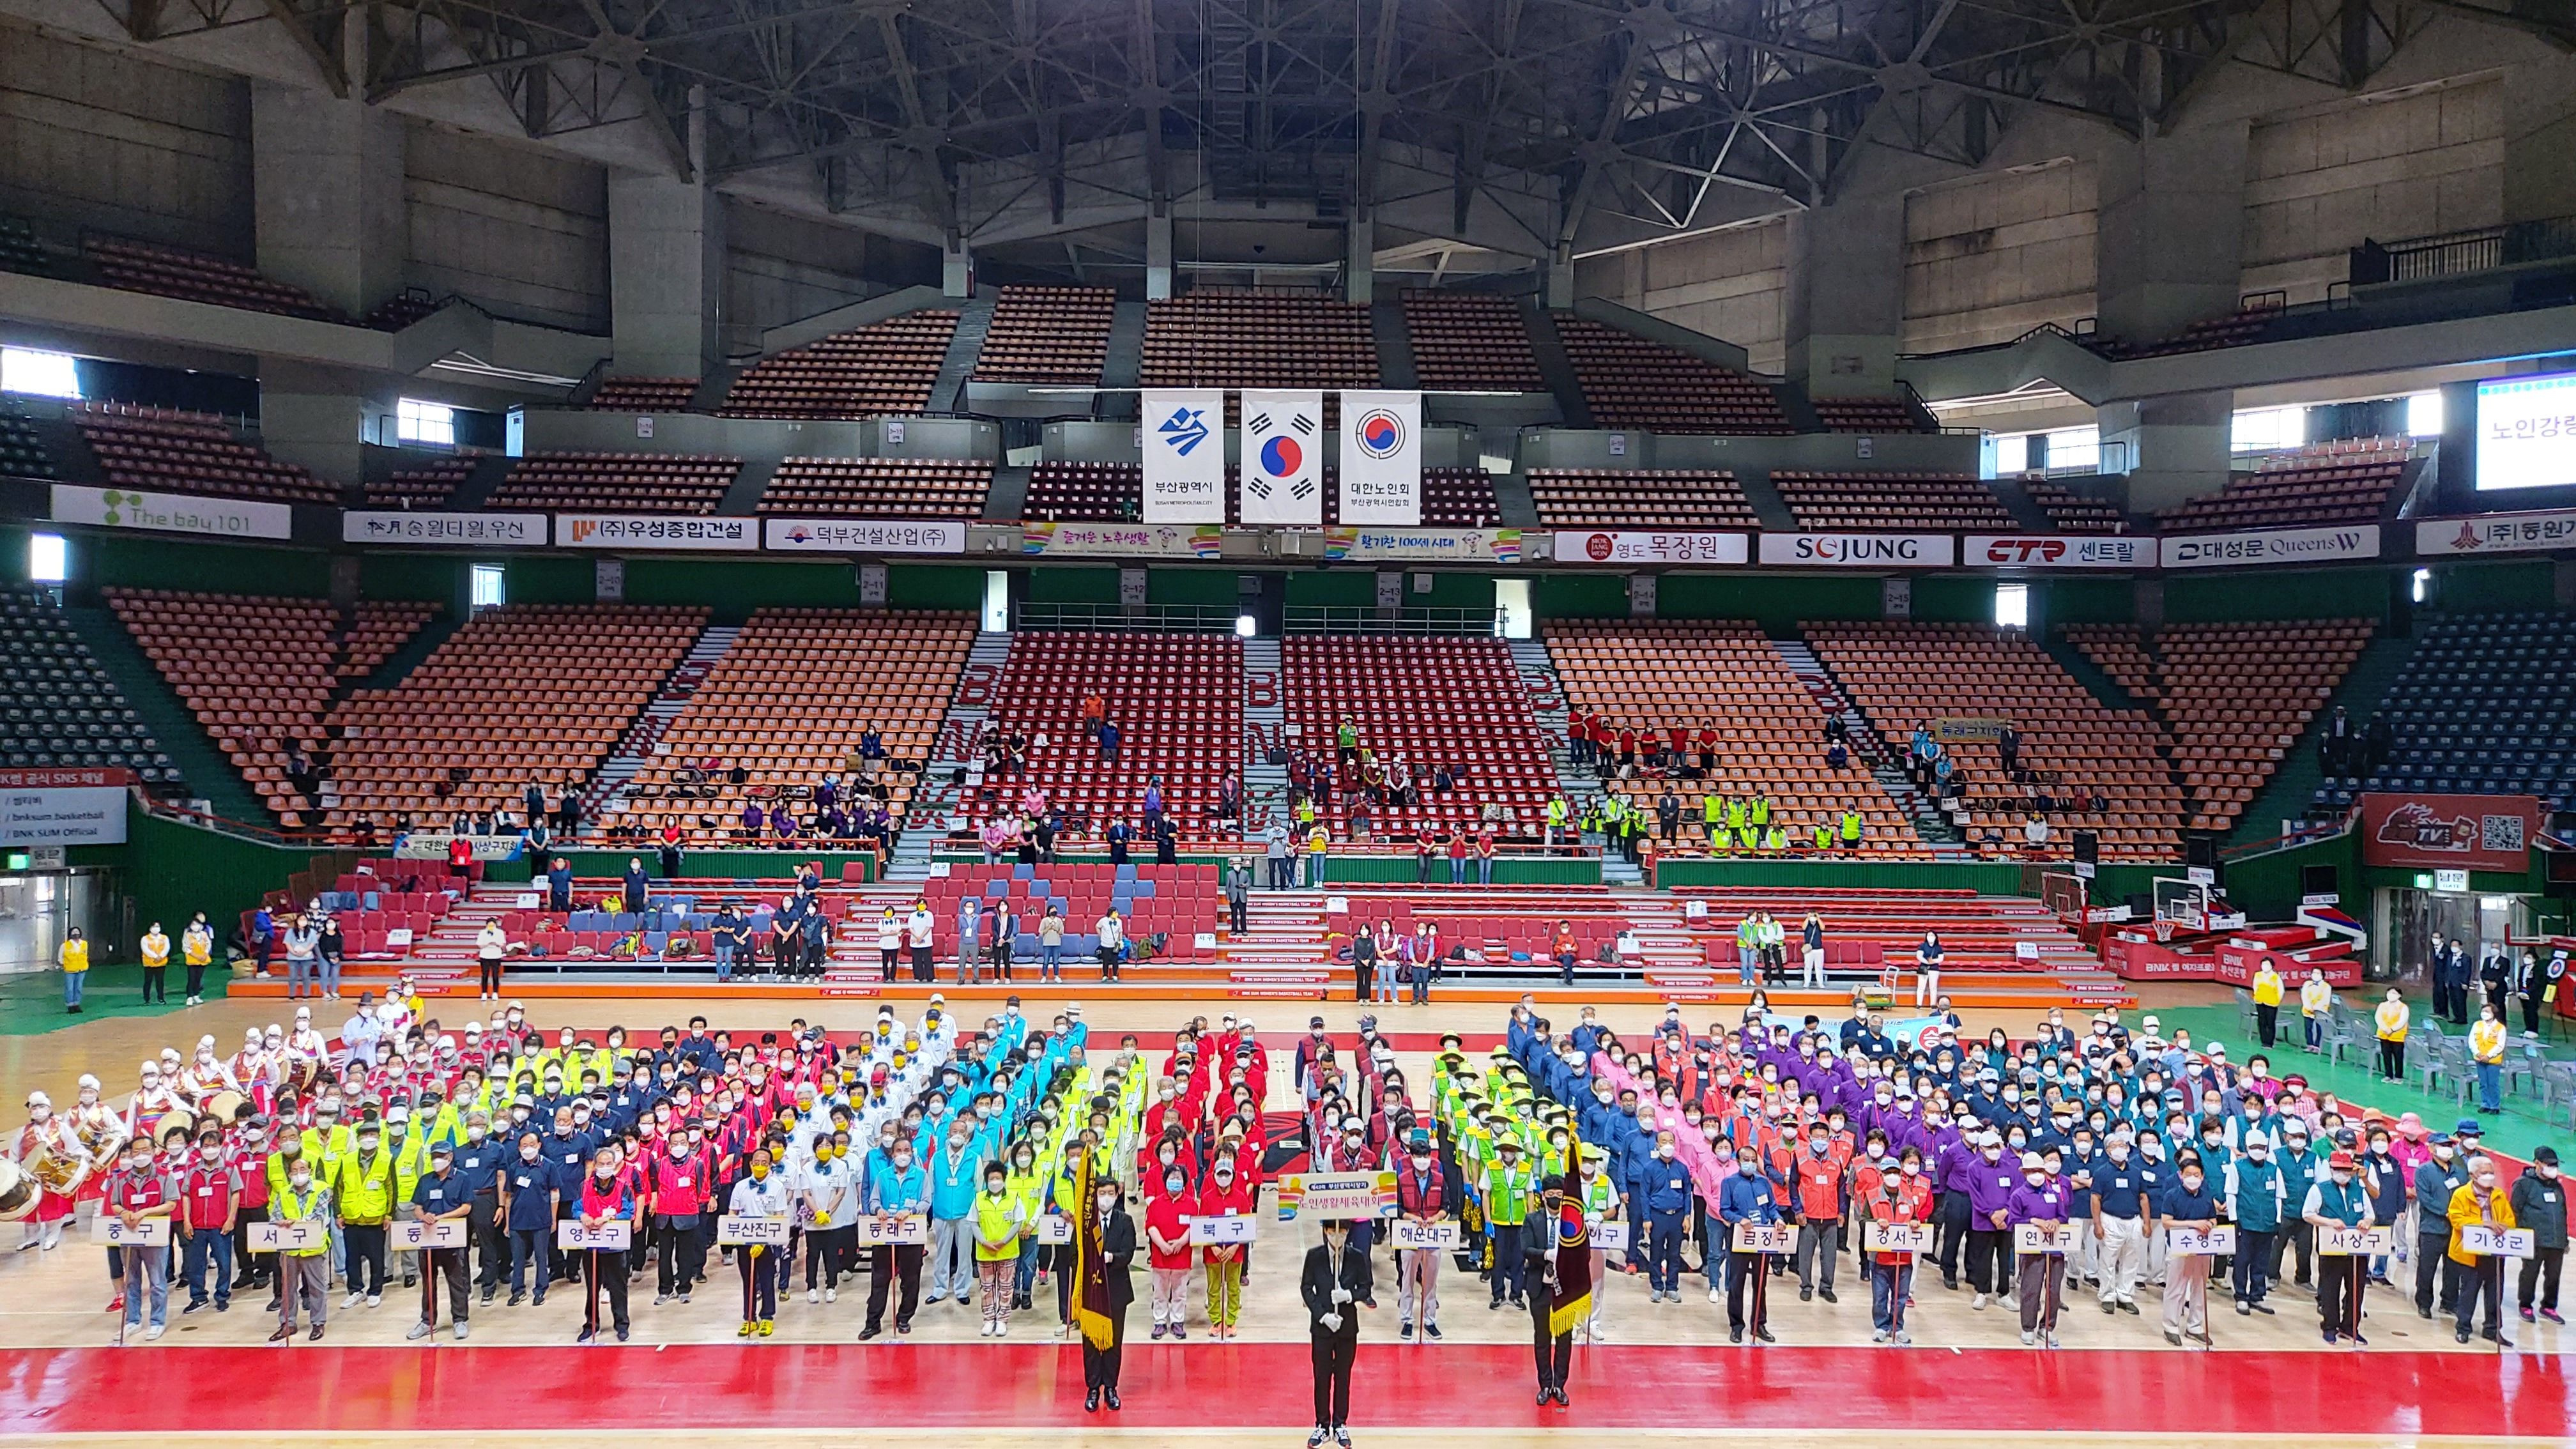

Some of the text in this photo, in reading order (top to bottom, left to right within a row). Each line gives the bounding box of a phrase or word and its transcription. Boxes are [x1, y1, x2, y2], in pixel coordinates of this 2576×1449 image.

[1155, 482, 1212, 493] 부산광역시
[1351, 483, 1409, 494] 대한노인회
[130, 508, 249, 532] The bay 101
[600, 521, 742, 539] (주)우성종합건설
[818, 527, 945, 546] 덕부건설산업(주)
[1063, 530, 1149, 546] 즐거운 노후생활
[1361, 535, 1454, 549] 활기찬 100세 시대
[1616, 536, 1717, 559] 영도 목장원
[1987, 540, 2066, 562] CTR
[2079, 542, 2135, 562] 센트랄
[863, 581, 883, 589] 2-11
[1123, 585, 1144, 593] 2-12
[1634, 591, 1654, 599] 2-14
[26, 773, 49, 785] 공식
[53, 773, 77, 784] SNS
[2418, 829, 2443, 841] TV
[2145, 963, 2170, 972] BNK
[2223, 954, 2244, 967] BNK
[2220, 965, 2247, 979] 부산은행
[1924, 1031, 1940, 1048] 승
[1299, 1196, 1381, 1209] 노인생활체육대회
[108, 1223, 153, 1239] 중구
[407, 1227, 451, 1243] 동구
[570, 1228, 619, 1242] 영도구
[727, 1222, 781, 1238] 부산진구
[869, 1222, 916, 1238] 동래구
[1054, 1222, 1067, 1237] 남
[1202, 1223, 1244, 1237] 북구
[1400, 1227, 1452, 1243] 해운대구
[1589, 1229, 1618, 1242] 하구
[263, 1229, 307, 1245] 서구
[1744, 1231, 1789, 1247] 금정구
[1877, 1229, 1923, 1245] 강서구
[2025, 1232, 2071, 1246] 연제구
[2181, 1234, 2225, 1247] 수영구
[2331, 1234, 2380, 1248] 사상구
[2474, 1233, 2523, 1250] 기장군
